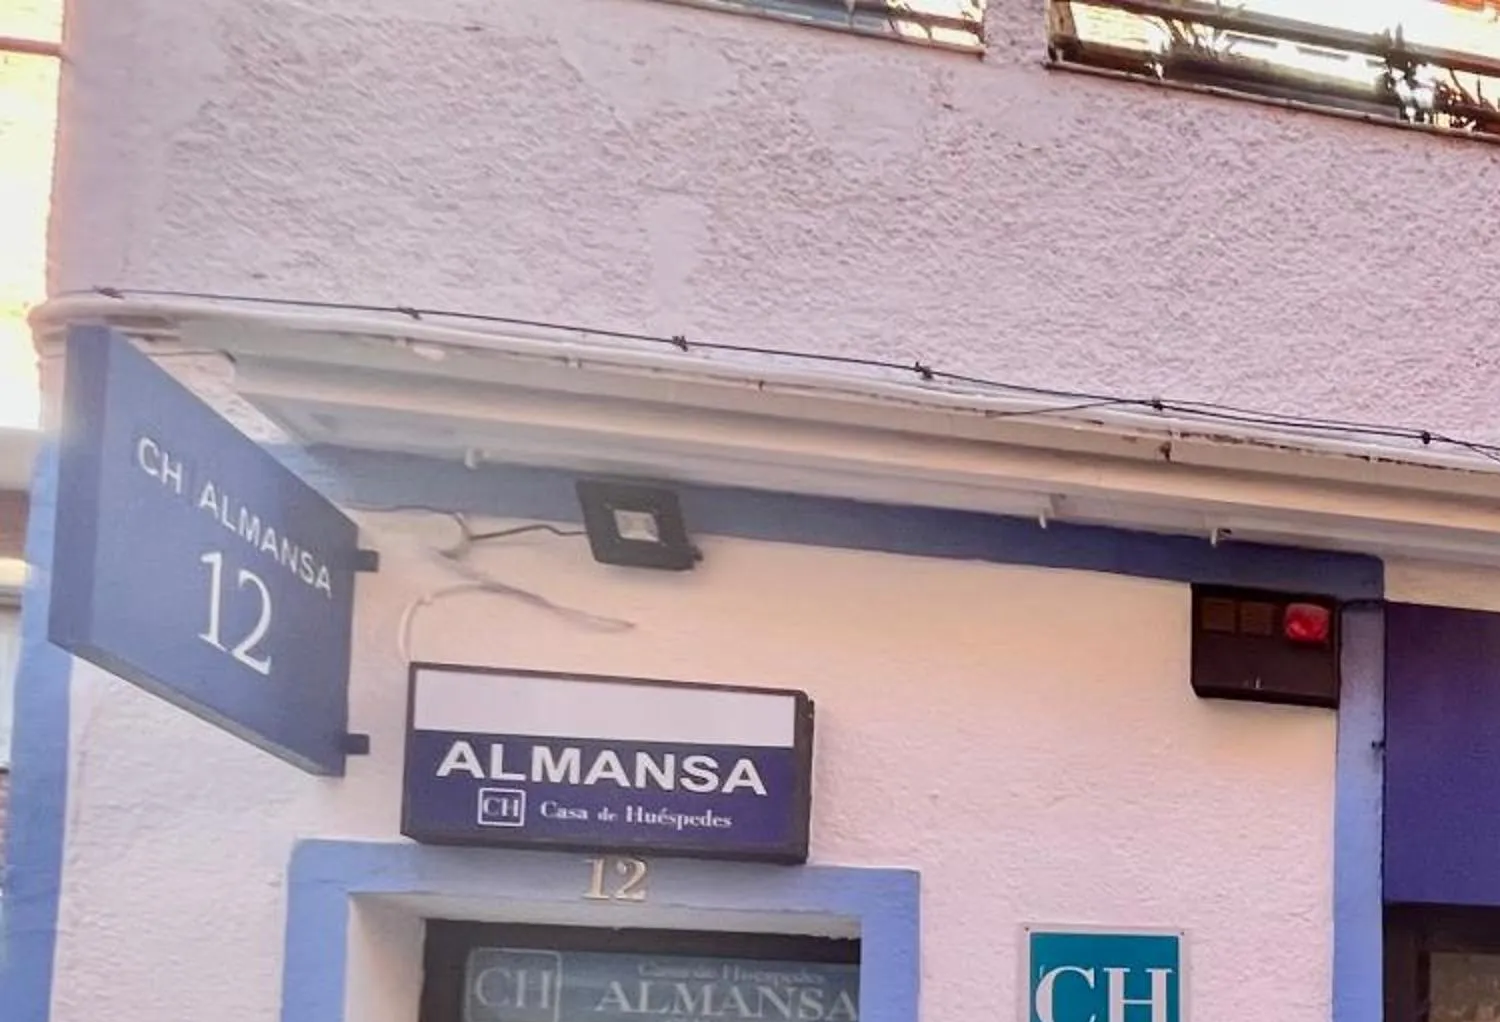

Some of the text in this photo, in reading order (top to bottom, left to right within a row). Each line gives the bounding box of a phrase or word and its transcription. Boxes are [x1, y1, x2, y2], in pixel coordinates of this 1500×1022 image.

[138, 437, 332, 599] CH ALMANSA
[198, 551, 271, 675] 12
[436, 741, 767, 796] ALMANSA
[540, 801, 588, 821] Casa
[597, 807, 618, 822] de
[626, 805, 733, 831] Huéspedes
[582, 857, 648, 901] 12
[475, 966, 554, 1010] CH
[594, 979, 858, 1022] ALMANSA
